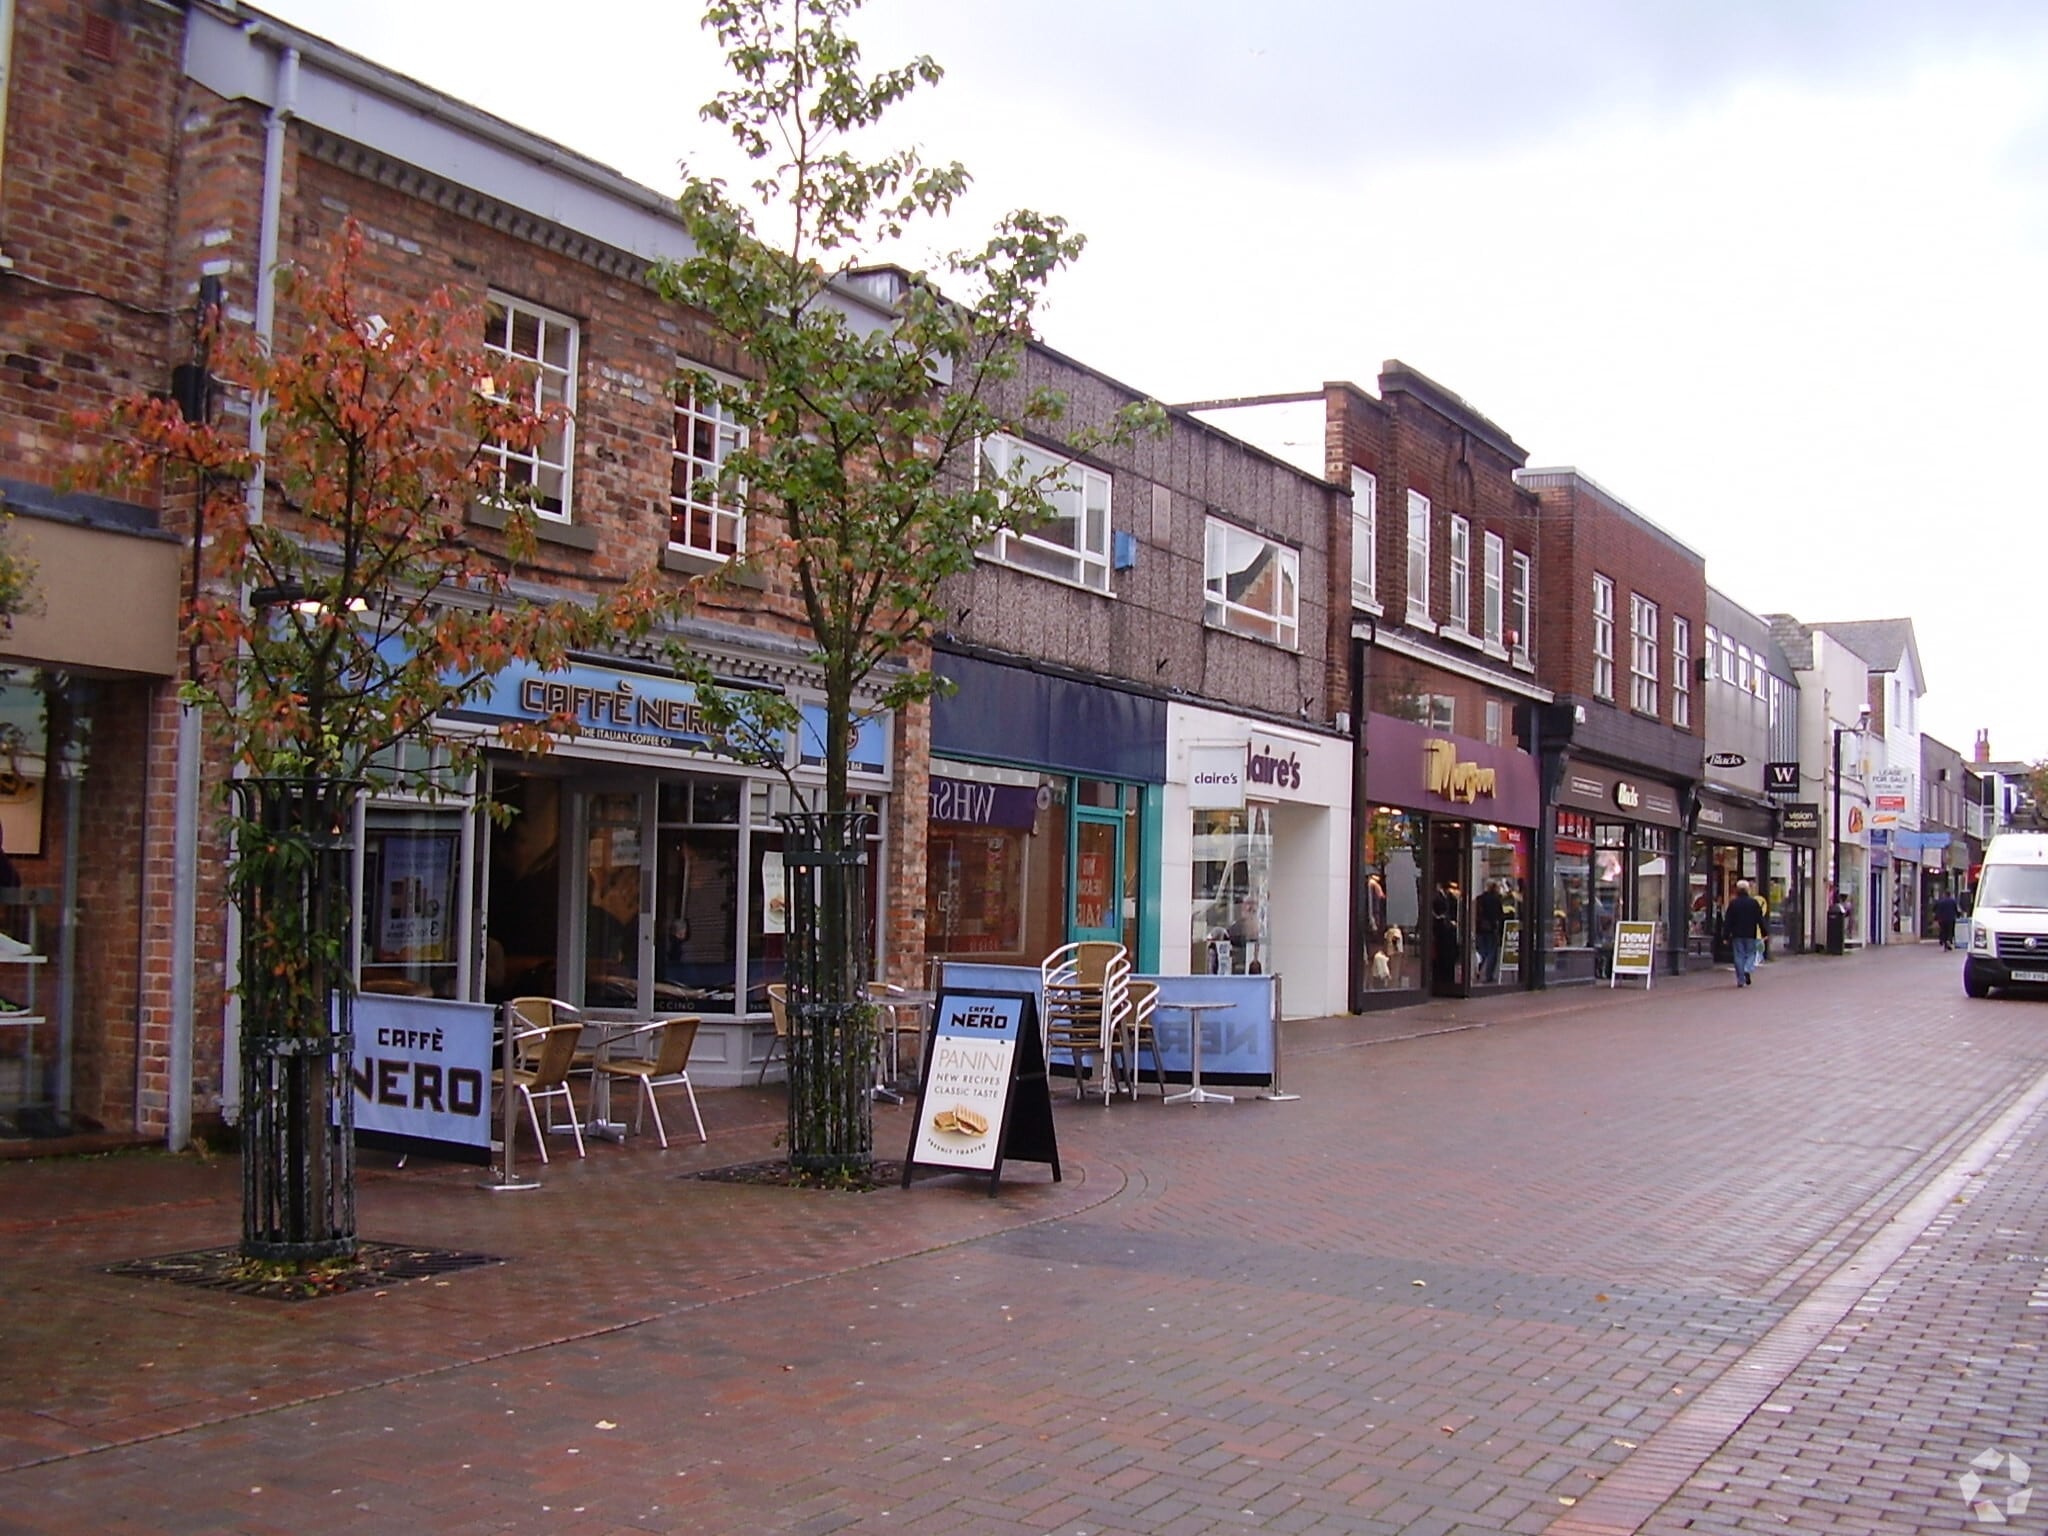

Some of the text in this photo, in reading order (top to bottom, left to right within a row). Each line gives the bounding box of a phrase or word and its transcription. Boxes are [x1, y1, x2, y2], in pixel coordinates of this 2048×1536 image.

[522, 679, 634, 724] CAFFÈ
[580, 727, 597, 738] THE
[597, 729, 629, 742] ITALIAN
[629, 734, 659, 746] COFFEE
[1246, 740, 1301, 790] laire's
[1194, 771, 1238, 784] claire's
[1773, 766, 1795, 783] W
[1788, 810, 1814, 820] vision
[1620, 932, 1651, 943] new
[951, 1013, 1008, 1030] NERO
[377, 1027, 444, 1052] CAFFÈ
[938, 1049, 1006, 1072] PANINI
[332, 1056, 483, 1118] NERO
[936, 1073, 1001, 1086] NEW RECIPES
[934, 1086, 999, 1099] CLASSIC TASTE
